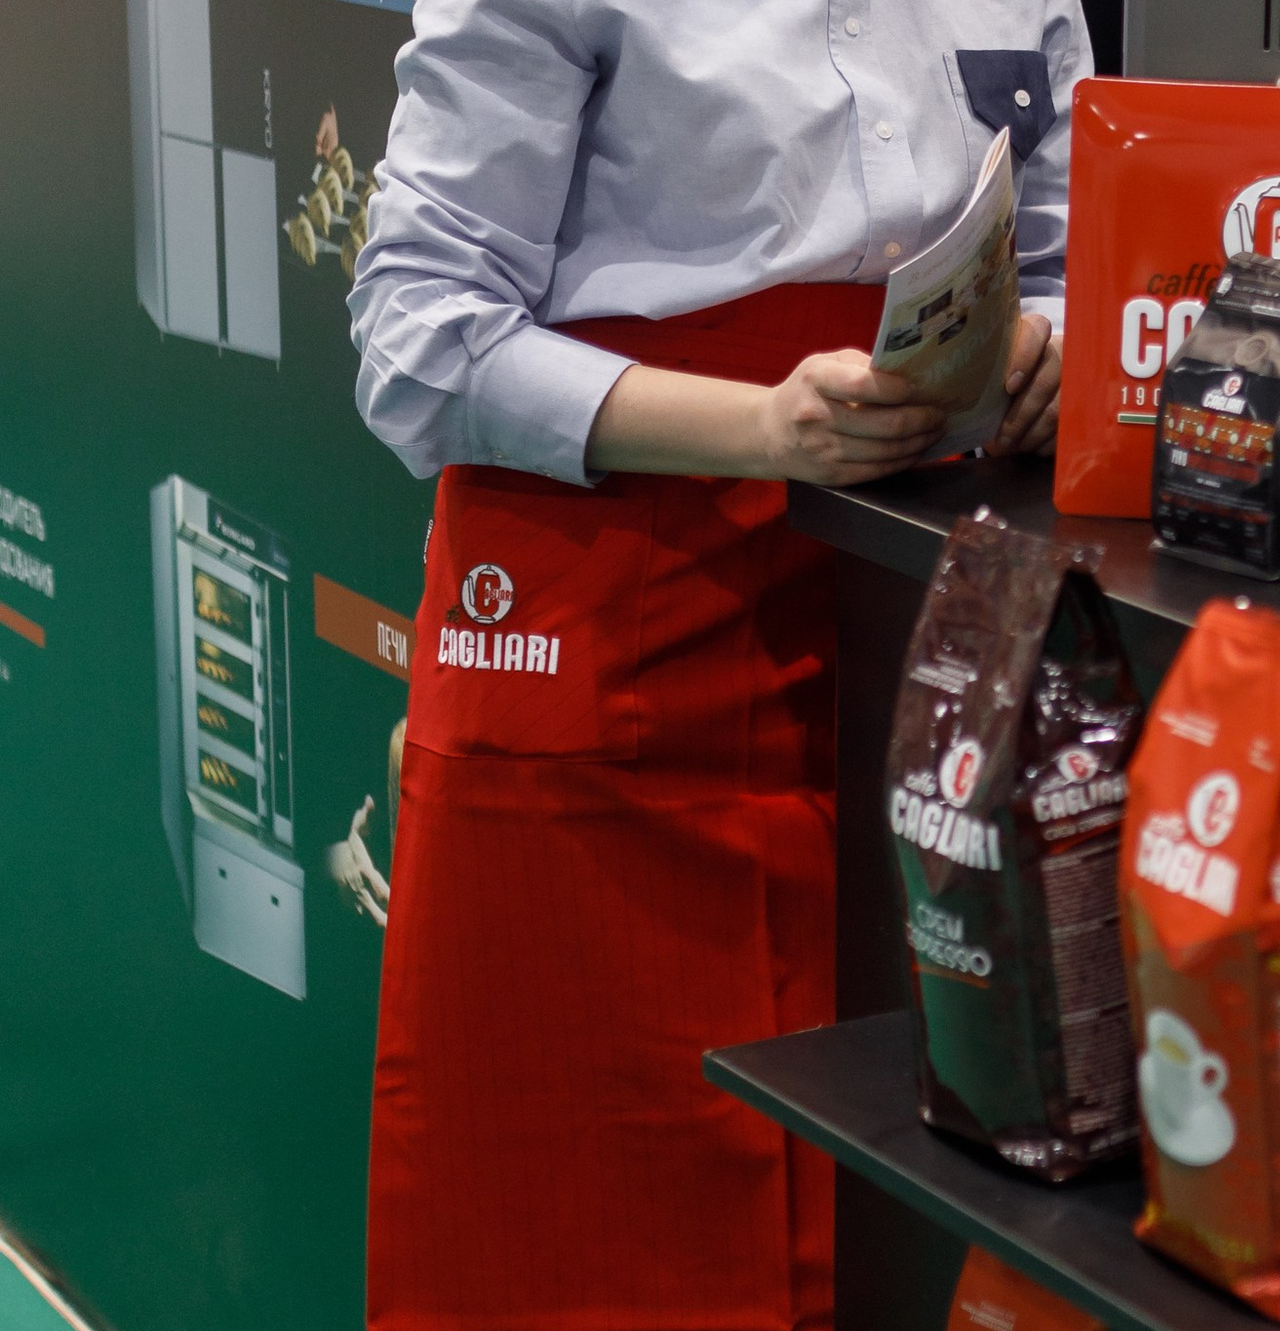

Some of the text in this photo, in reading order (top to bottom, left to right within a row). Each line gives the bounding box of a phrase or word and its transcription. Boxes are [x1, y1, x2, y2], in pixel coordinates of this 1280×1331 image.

[377, 621, 407, 669] ПЕЧИ
[438, 627, 561, 675] CAGLIARI
[1032, 771, 1128, 823] CAGLIAR
